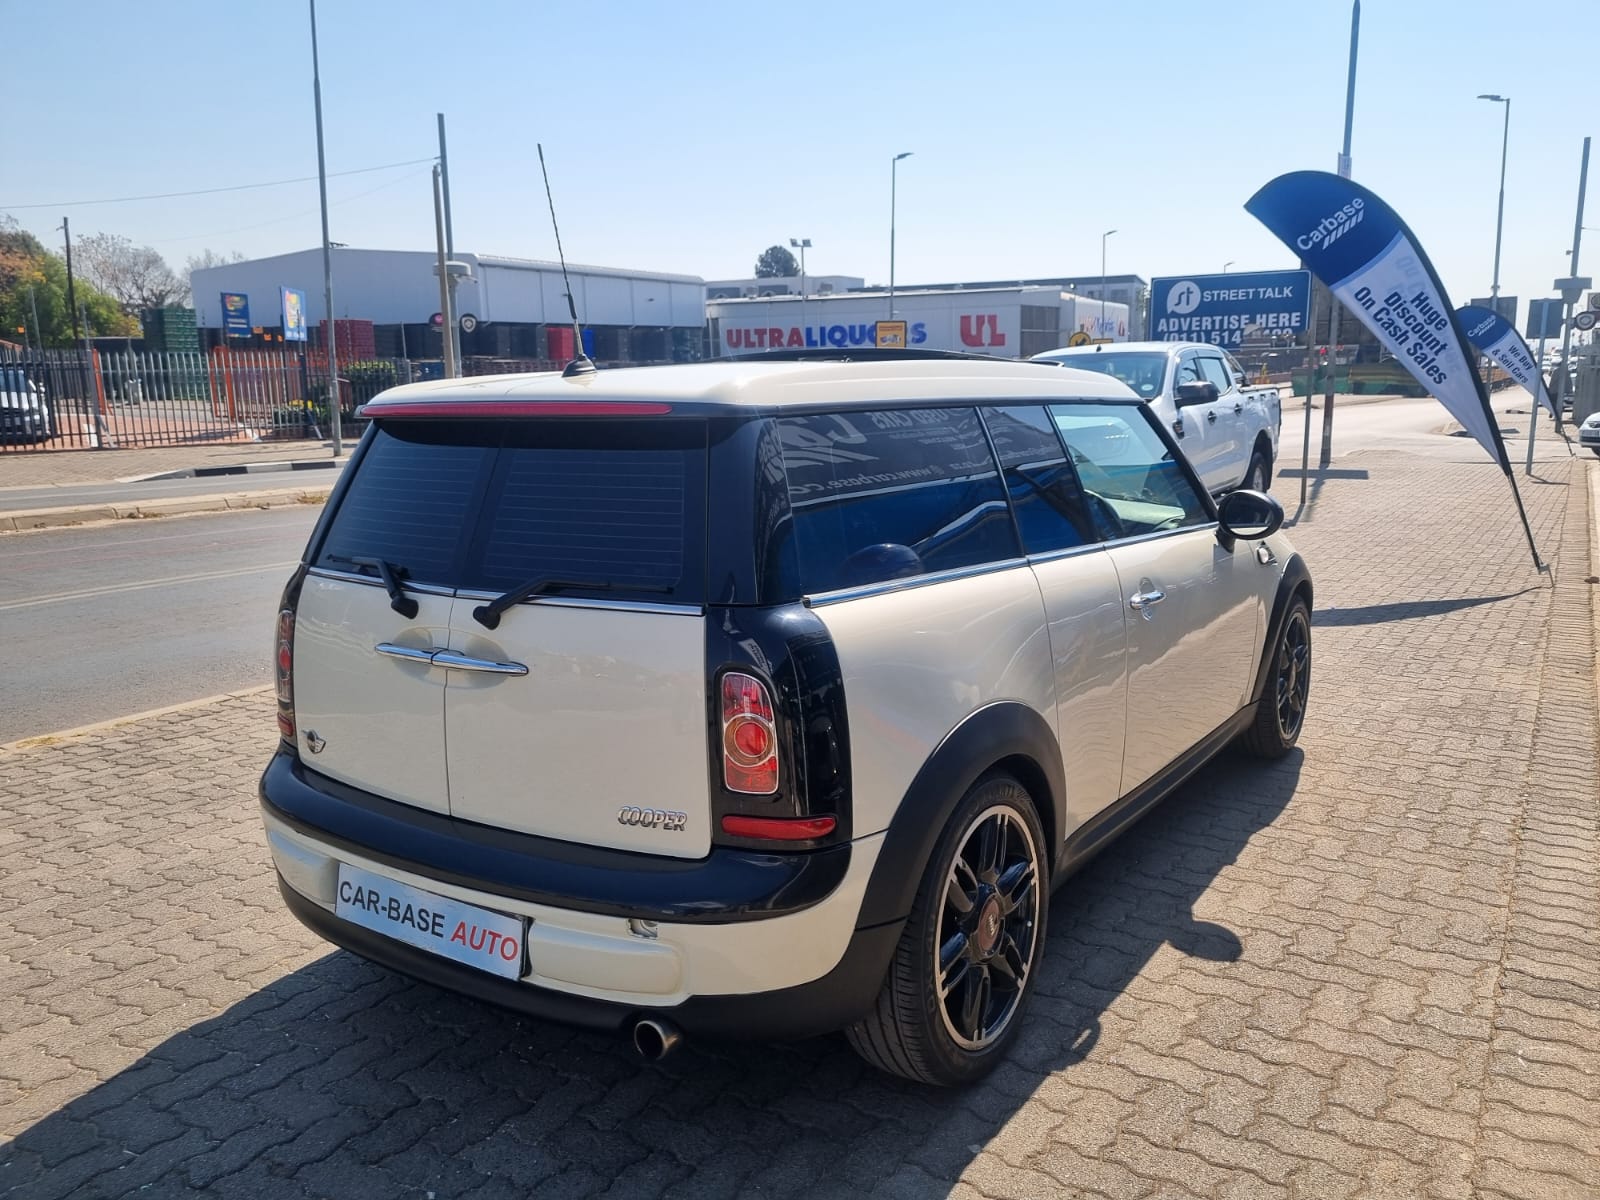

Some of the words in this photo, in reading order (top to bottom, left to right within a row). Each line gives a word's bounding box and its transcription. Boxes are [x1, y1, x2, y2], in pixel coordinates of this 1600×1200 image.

[1297, 198, 1364, 250] Carbase
[1203, 288, 1256, 302] STREET
[1257, 286, 1293, 299] TALK
[1157, 314, 1250, 332] ADVERTISE
[1255, 312, 1301, 327] HERE
[1384, 291, 1448, 356] Discount
[1410, 291, 1448, 331] Huge
[726, 322, 927, 349] ULTRALIQUS
[960, 315, 1006, 347] UL
[1211, 330, 1242, 344] 514
[1354, 287, 1376, 310] On
[1373, 307, 1409, 346] Cash
[1406, 342, 1447, 384] Sales
[618, 806, 687, 831] COOPER
[340, 881, 445, 938] CAR-BASE
[451, 921, 518, 961] AUTO
